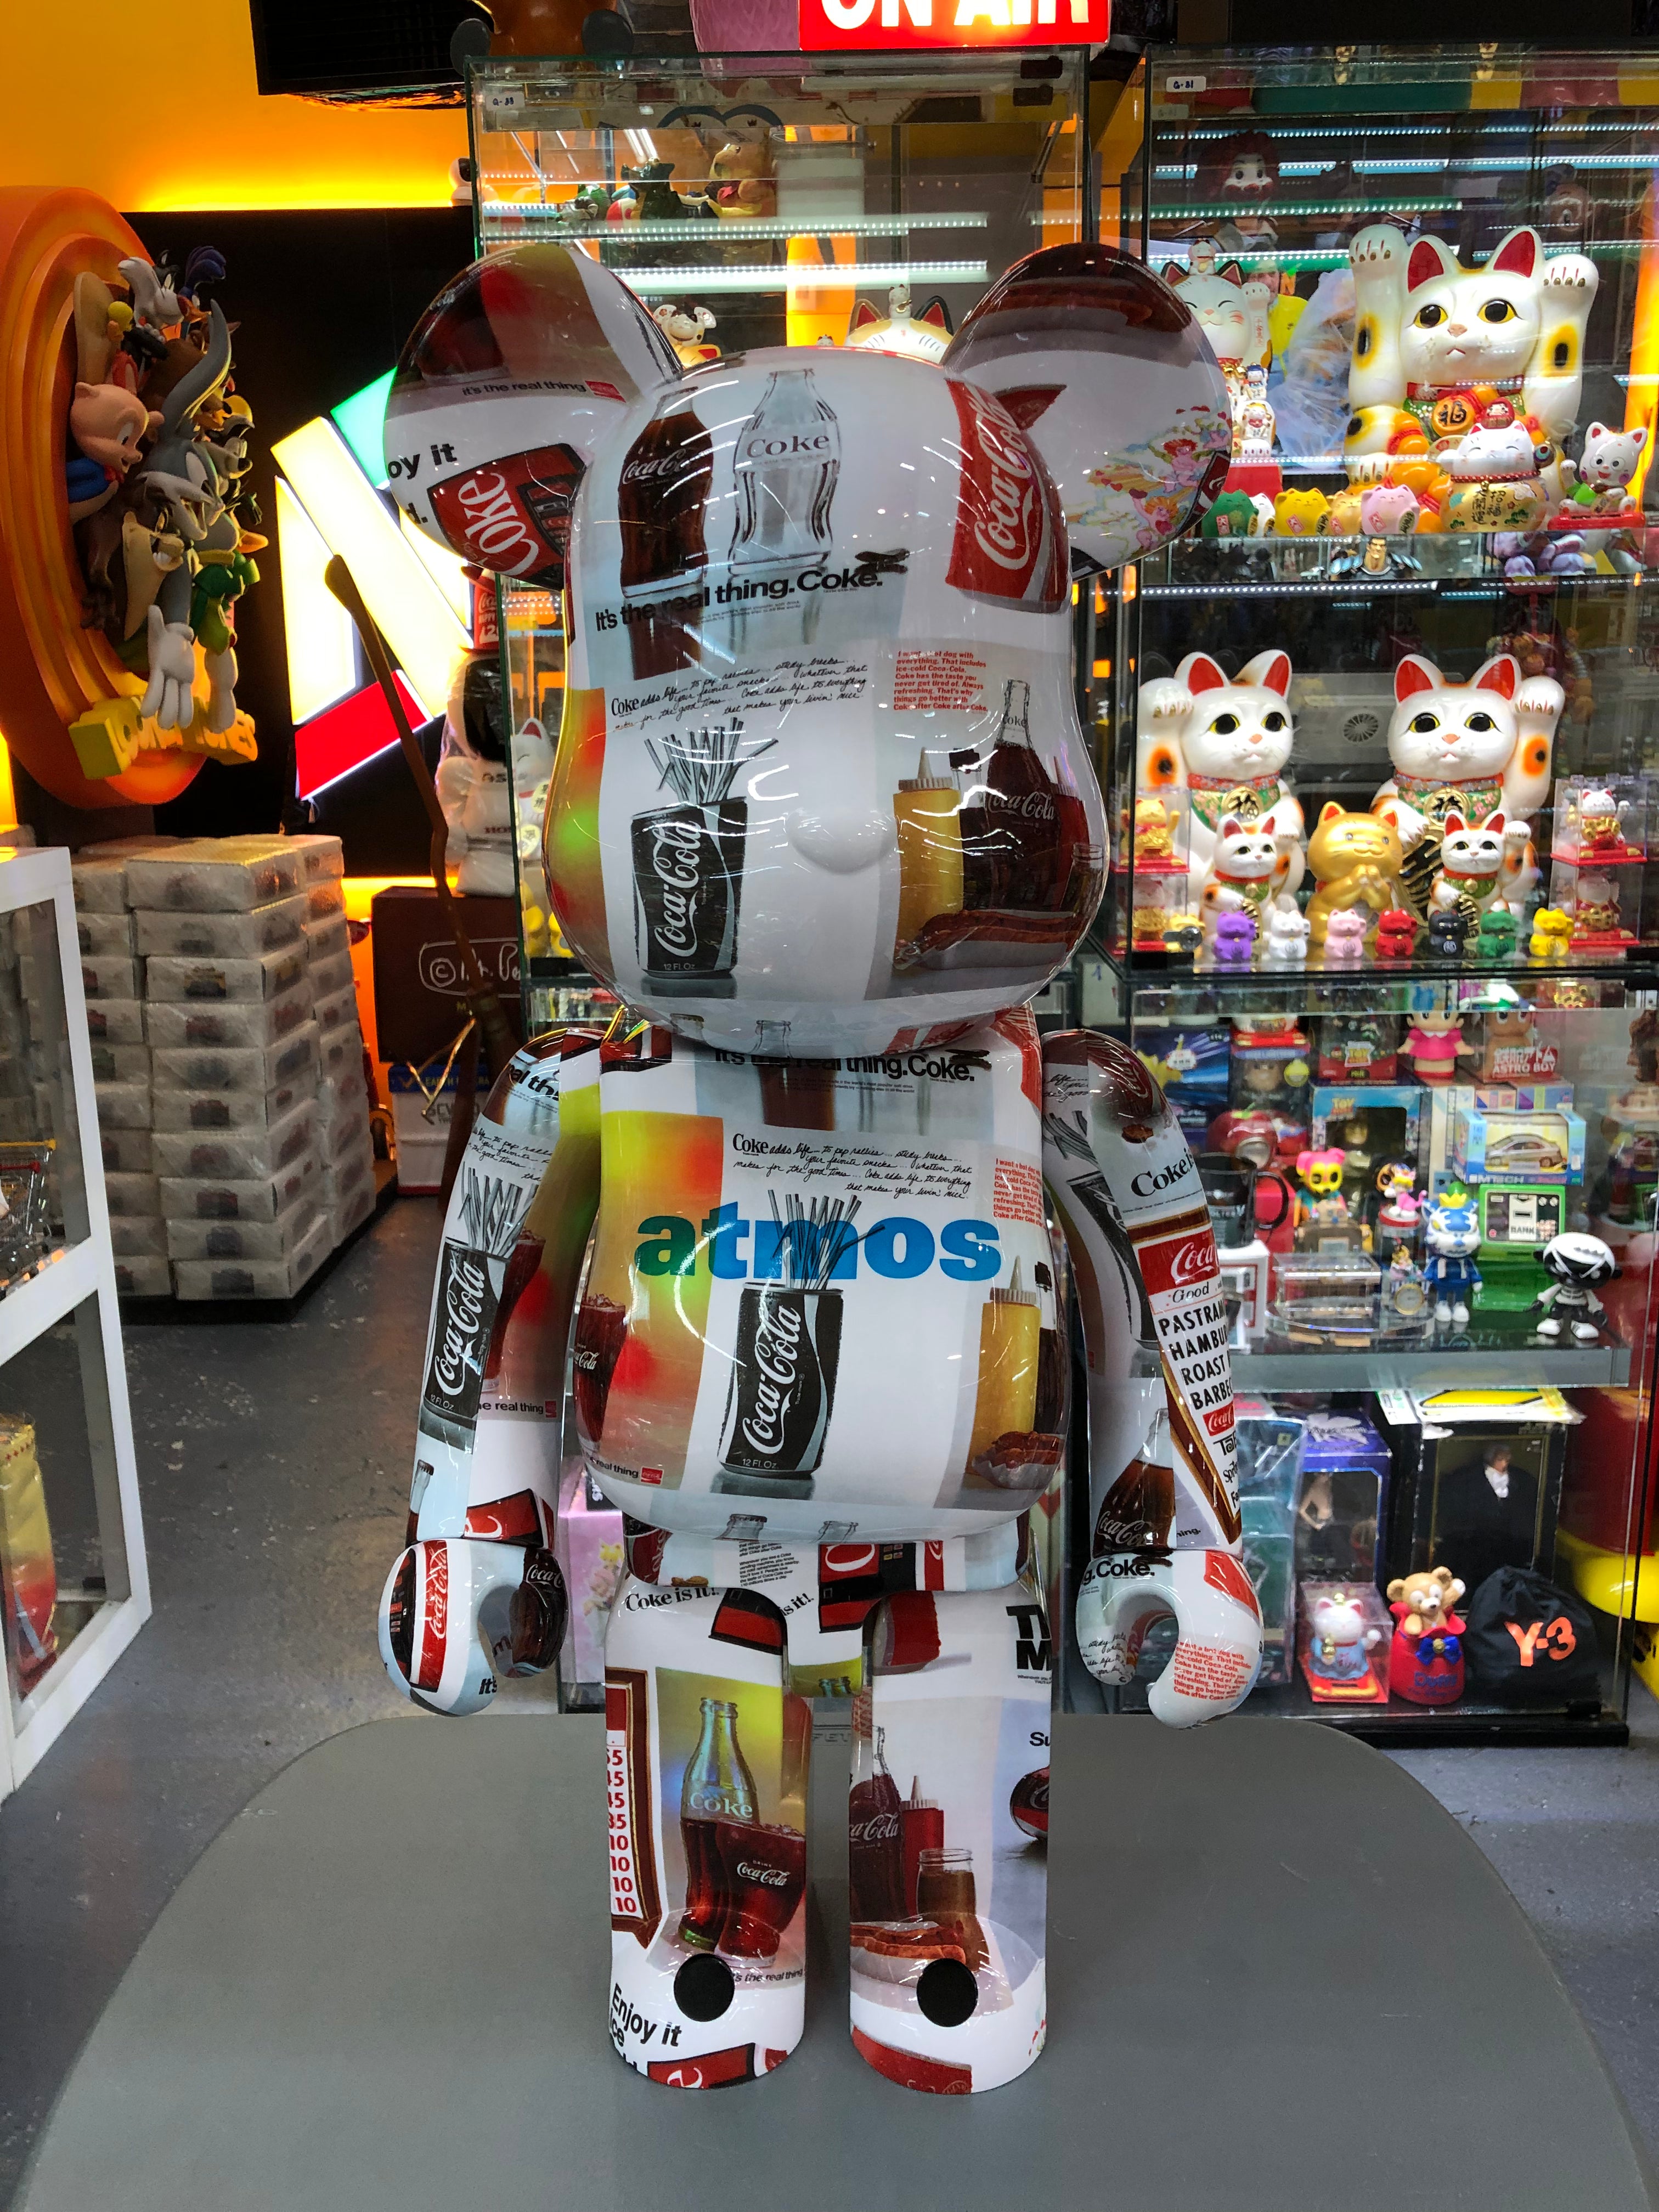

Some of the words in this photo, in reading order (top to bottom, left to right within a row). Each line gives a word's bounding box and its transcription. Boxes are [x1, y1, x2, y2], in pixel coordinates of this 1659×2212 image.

[462, 387, 481, 396] it's
[484, 384, 510, 393] the
[511, 382, 541, 391] real
[544, 381, 586, 392] thing
[430, 443, 457, 466] it
[747, 435, 830, 459] Coke
[963, 382, 1040, 570] Coca-Cola
[596, 607, 618, 631] It's
[620, 602, 656, 625] the
[928, 665, 966, 673] Coca-Cola.
[960, 659, 986, 668] includes
[962, 681, 984, 690] Always
[612, 698, 639, 716] Coke
[652, 820, 702, 957] Coca-Cola
[733, 1133, 769, 1154] Coke
[769, 1144, 792, 1154] adds
[821, 1146, 834, 1154] to
[834, 1148, 849, 1157] pep
[895, 1150, 921, 1169] study
[804, 1155, 825, 1169] your
[826, 1155, 861, 1169] favorite
[950, 1165, 972, 1173] that
[733, 1161, 765, 1169] makes
[766, 1163, 784, 1177] for
[786, 1165, 806, 1174] the
[803, 1168, 827, 1182] good
[865, 1169, 883, 1179] Coke
[924, 1175, 935, 1183] to
[935, 1176, 972, 1193] everything
[845, 1183, 862, 1191] that
[894, 1187, 913, 1199] your
[993, 1204, 1013, 1212] things
[635, 1201, 1001, 1281] atmos
[1172, 1284, 1210, 1304] Good
[435, 1255, 486, 1396] Coca-Cola
[742, 1305, 802, 1454] Coca-Cola
[1182, 1356, 1226, 1385] ROAST
[495, 1401, 518, 1411] real
[520, 1402, 544, 1415] thing
[596, 1460, 612, 1471] real
[613, 1465, 639, 1479] thing
[625, 1593, 672, 1612] Coke
[675, 1588, 692, 1602] is
[1504, 1616, 1577, 1667] Y-3
[1175, 1658, 1192, 1668] Coke
[1193, 1663, 1205, 1672] has
[1217, 1656, 1231, 1664] That
[478, 1675, 498, 1695] It's
[1174, 1679, 1194, 1690] things
[1208, 1674, 1223, 1683] tired
[1174, 1686, 1190, 1696] Coke
[690, 1792, 753, 1818] Coke
[610, 1834, 629, 1851] 10
[611, 1855, 630, 1872] 10
[737, 1861, 791, 1886] Coca-Cola
[613, 1876, 634, 1893] 10
[615, 1897, 637, 1914] 10
[744, 1973, 763, 1983] the
[765, 1973, 785, 1982] real
[785, 1969, 804, 1980] thing
[611, 1982, 657, 2045] Enjoy
[662, 2022, 682, 2047] it
